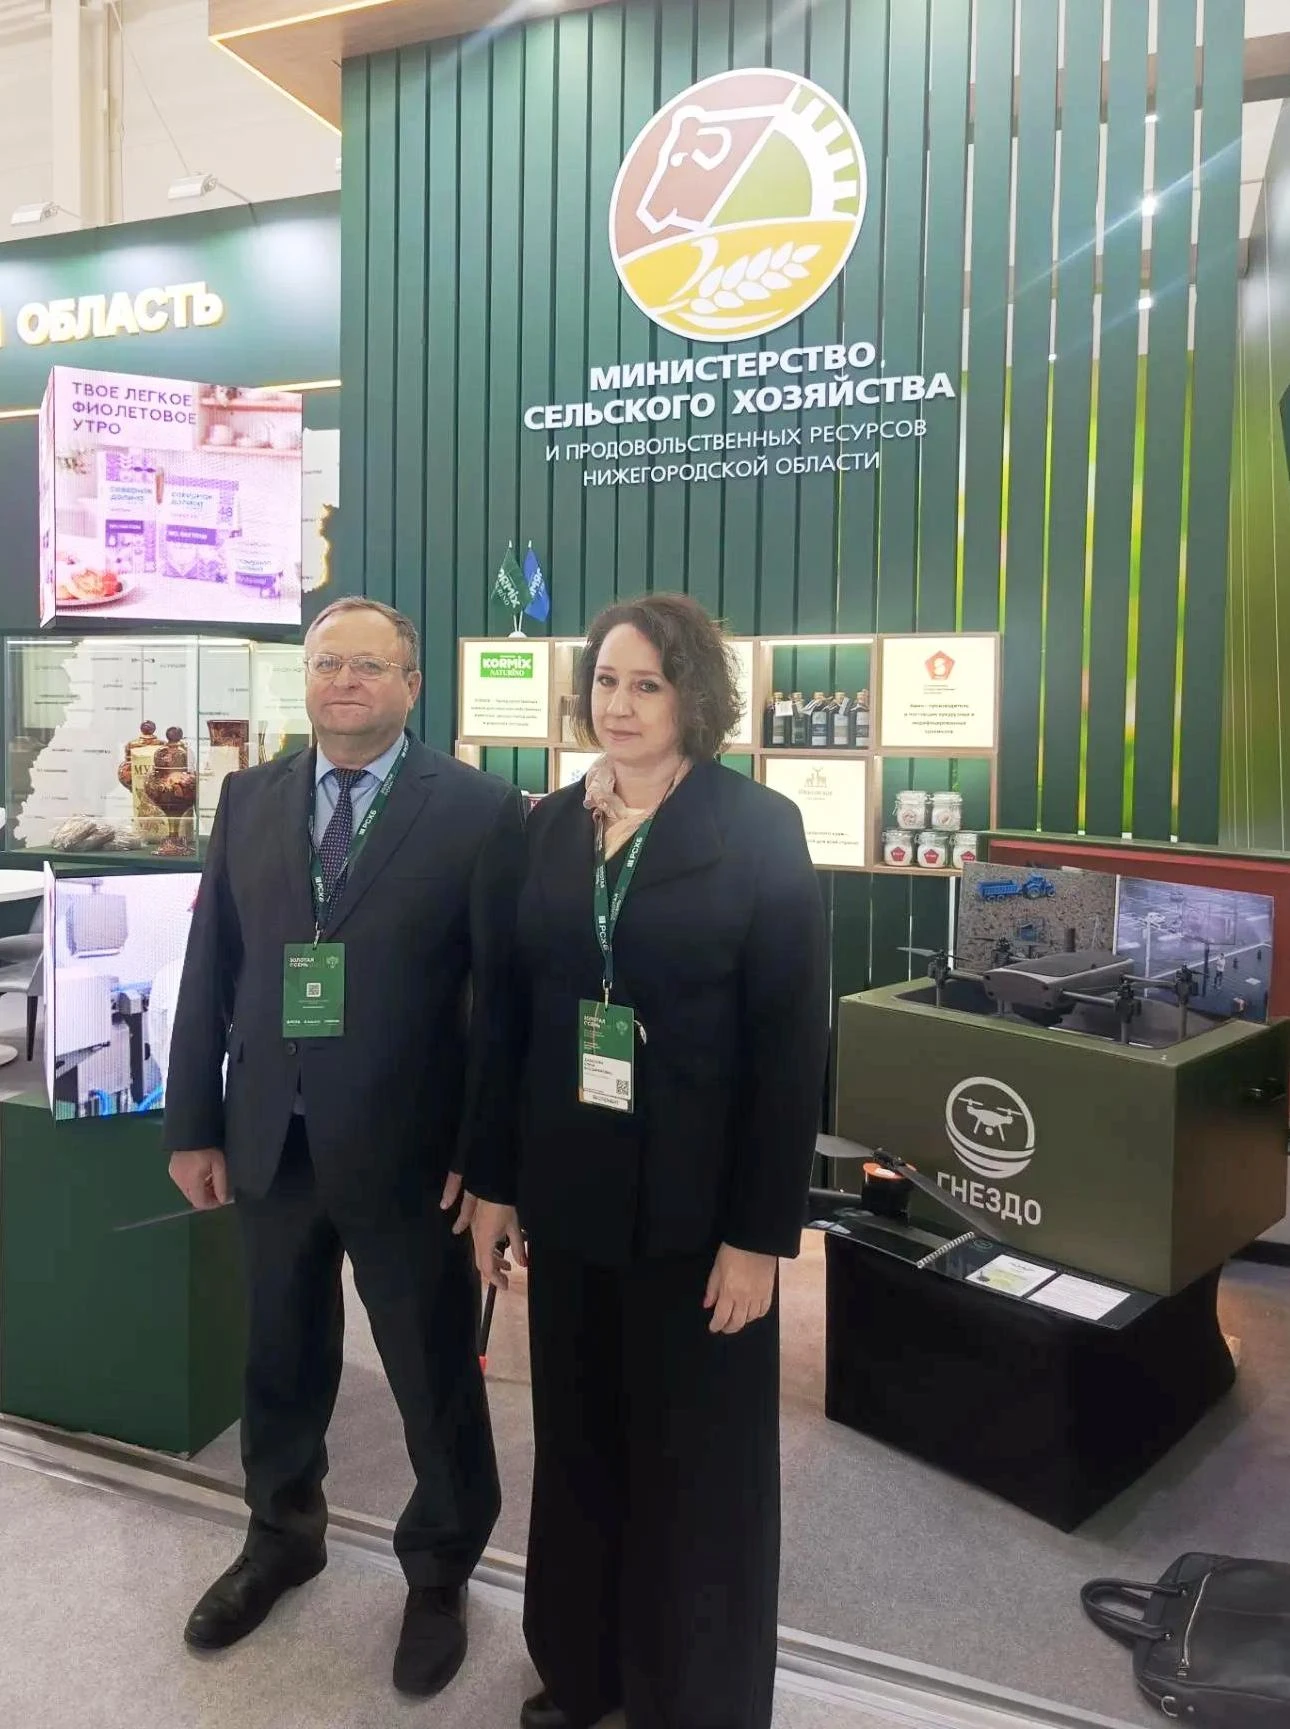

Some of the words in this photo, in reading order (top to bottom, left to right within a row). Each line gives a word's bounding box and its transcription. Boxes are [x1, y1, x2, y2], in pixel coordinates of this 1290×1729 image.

[17, 281, 223, 345] ОБЛАСТЬ
[589, 341, 876, 391] МИНИСТЕРСТВО
[72, 381, 119, 399] ТВОЕ
[124, 388, 193, 407] ЛЕГКОЕ
[72, 401, 197, 425] ФИОЛЕТОВОЕ
[523, 392, 715, 430] СЕЛЬСКОГО
[732, 372, 956, 415] ХОЗЯЙСТВА
[72, 418, 122, 436] УТРО
[545, 444, 561, 462] И
[565, 428, 802, 461] ПРОДОВОЛЬСТВЕННЫХ
[809, 418, 928, 445] РЕСУРСОВ
[582, 455, 769, 487] НИЖЕГОРОДСКОЙ
[775, 451, 880, 475] ОБЛАСТИ
[937, 1171, 1042, 1226] ГНЕЗДО
